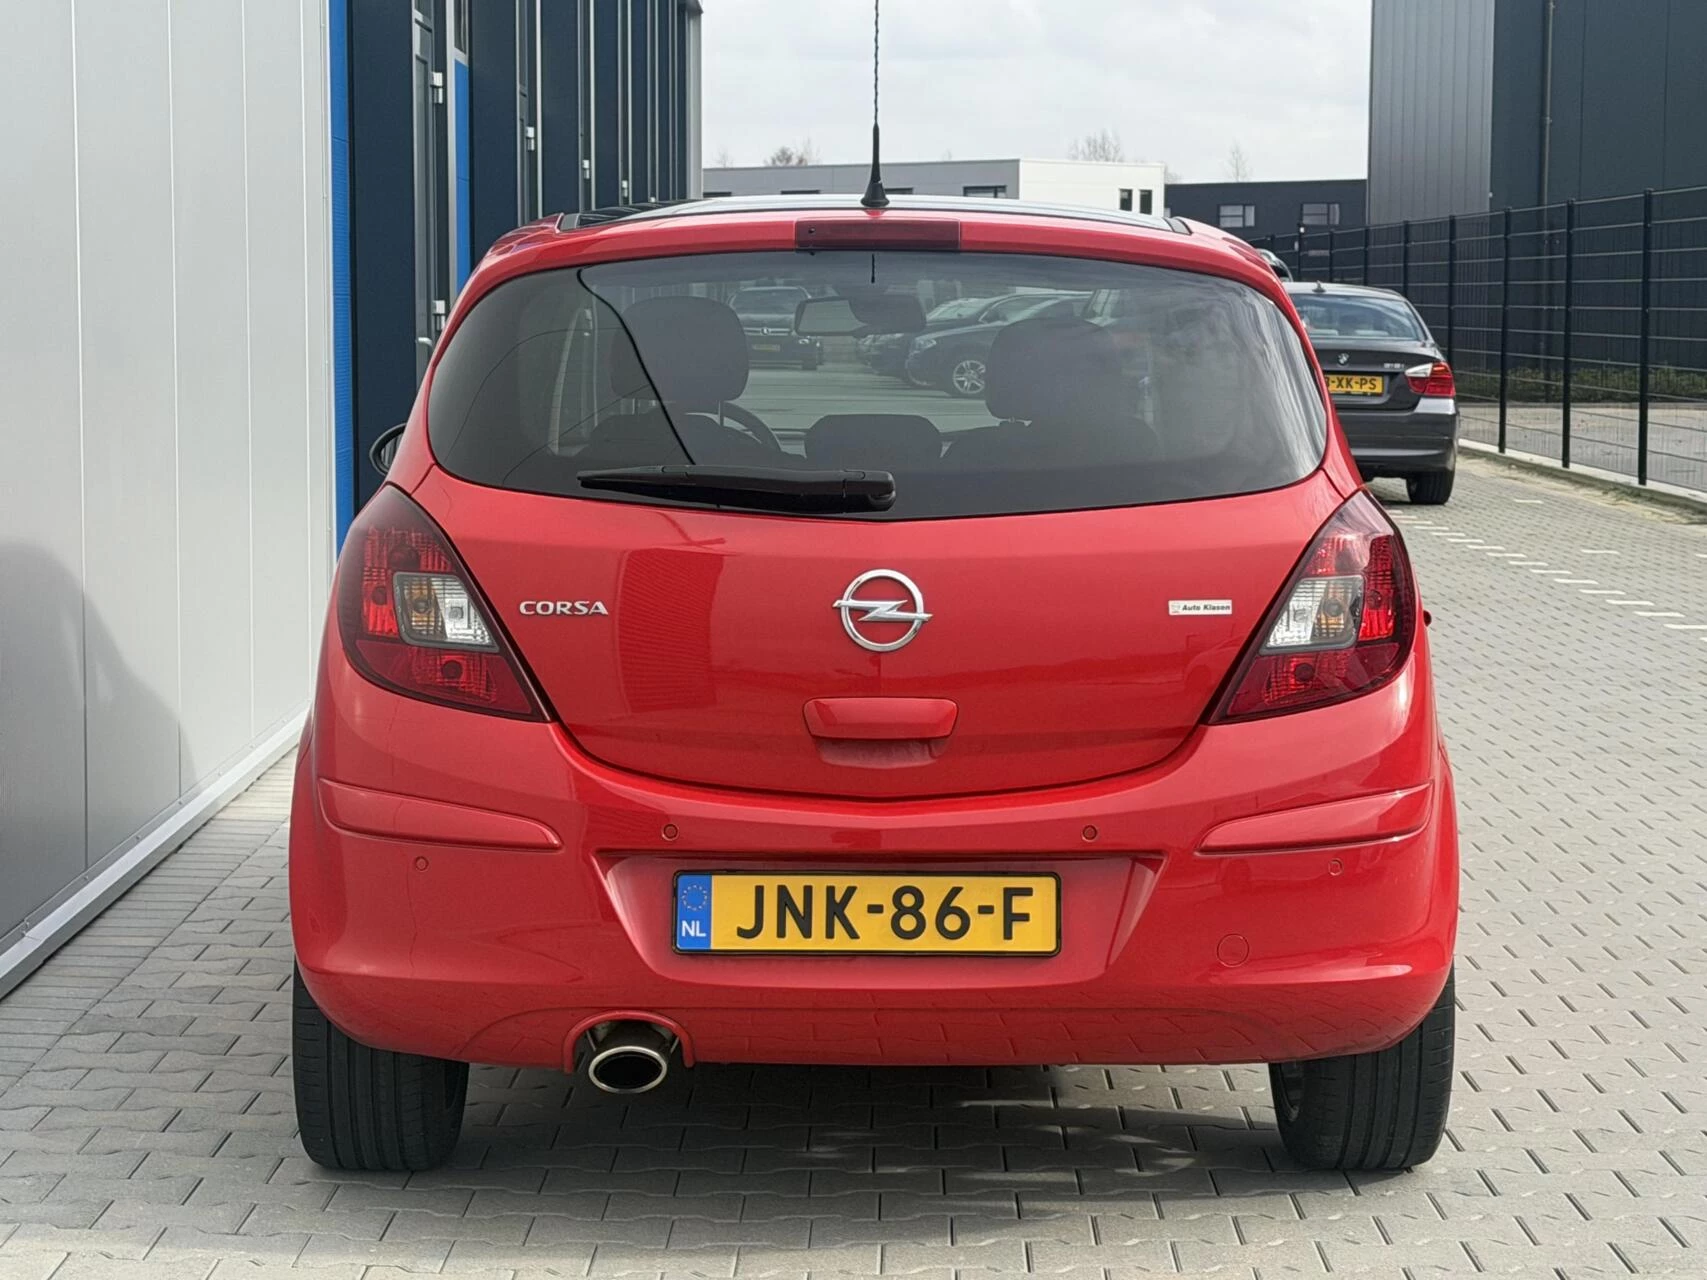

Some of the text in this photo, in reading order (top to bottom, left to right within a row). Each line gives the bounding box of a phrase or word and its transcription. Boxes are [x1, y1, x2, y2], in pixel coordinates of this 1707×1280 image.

[519, 600, 609, 616] CORSA
[736, 885, 1034, 941] JNK-86-F
[681, 920, 707, 938] NL
